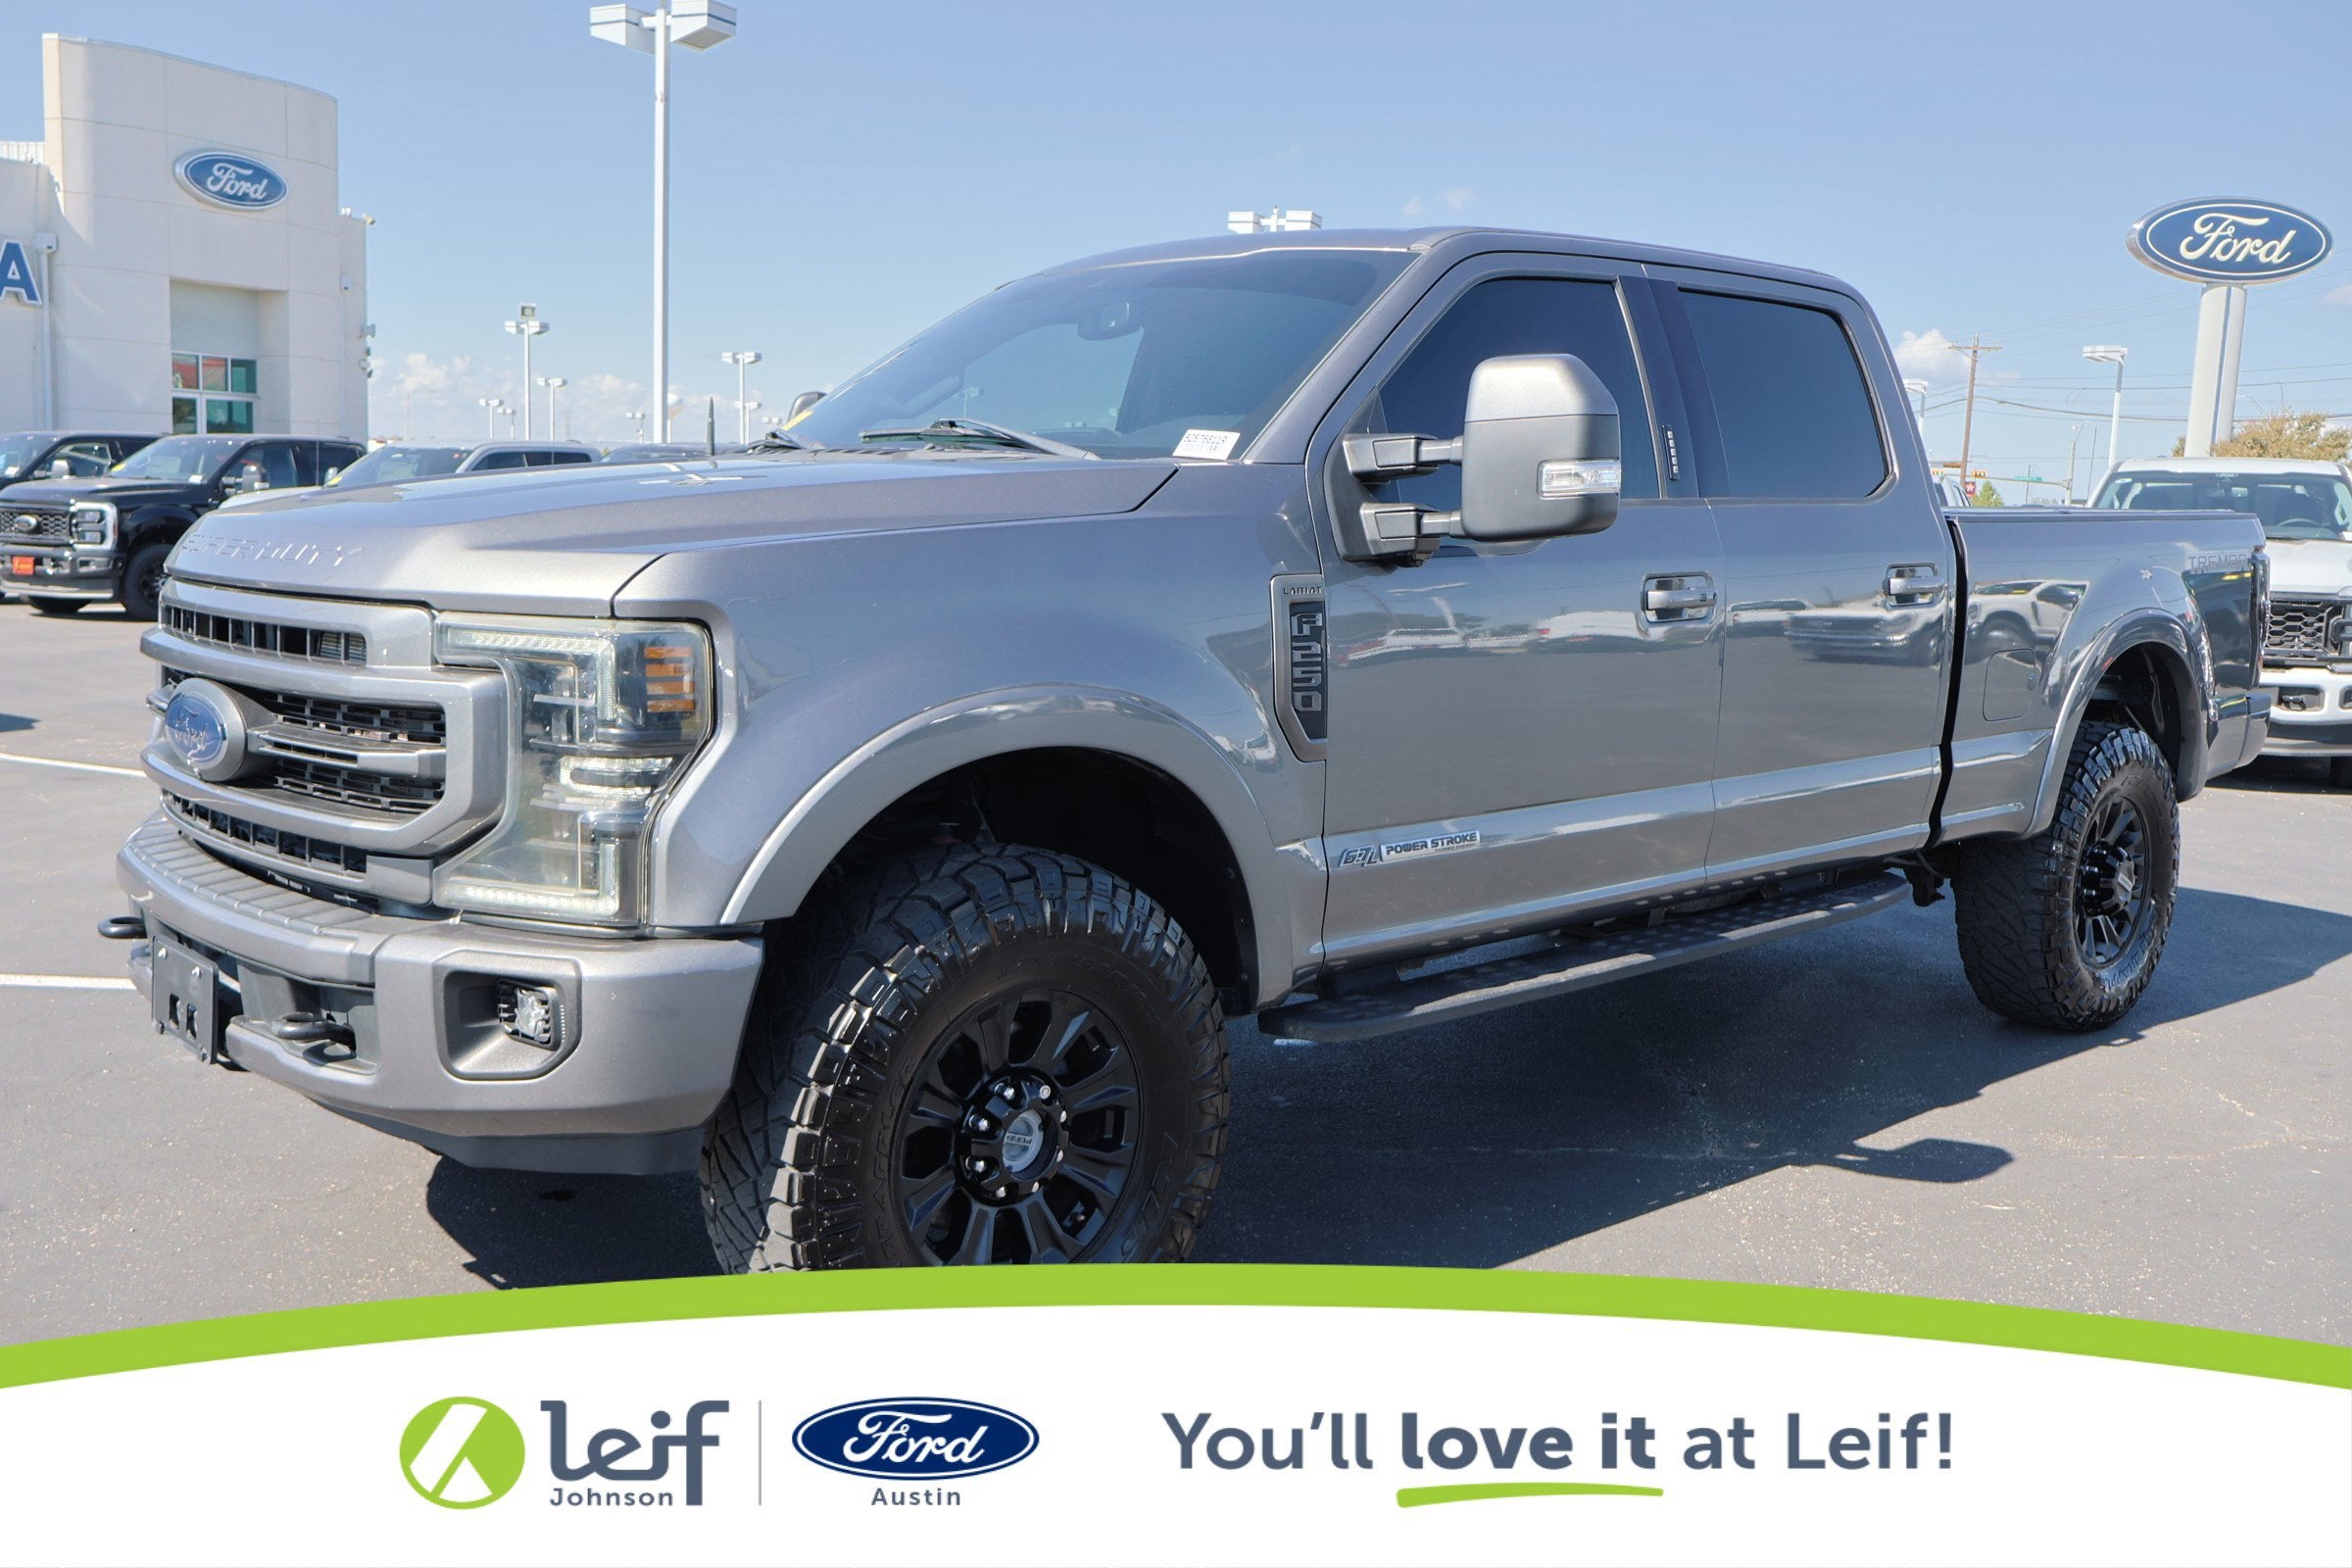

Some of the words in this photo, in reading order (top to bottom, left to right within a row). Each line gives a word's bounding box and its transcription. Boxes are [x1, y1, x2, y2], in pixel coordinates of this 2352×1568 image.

[207, 163, 269, 200] Ford
[2180, 203, 2296, 265] Ford
[1386, 840, 1429, 856] POWER
[1430, 832, 1478, 849] STROKE
